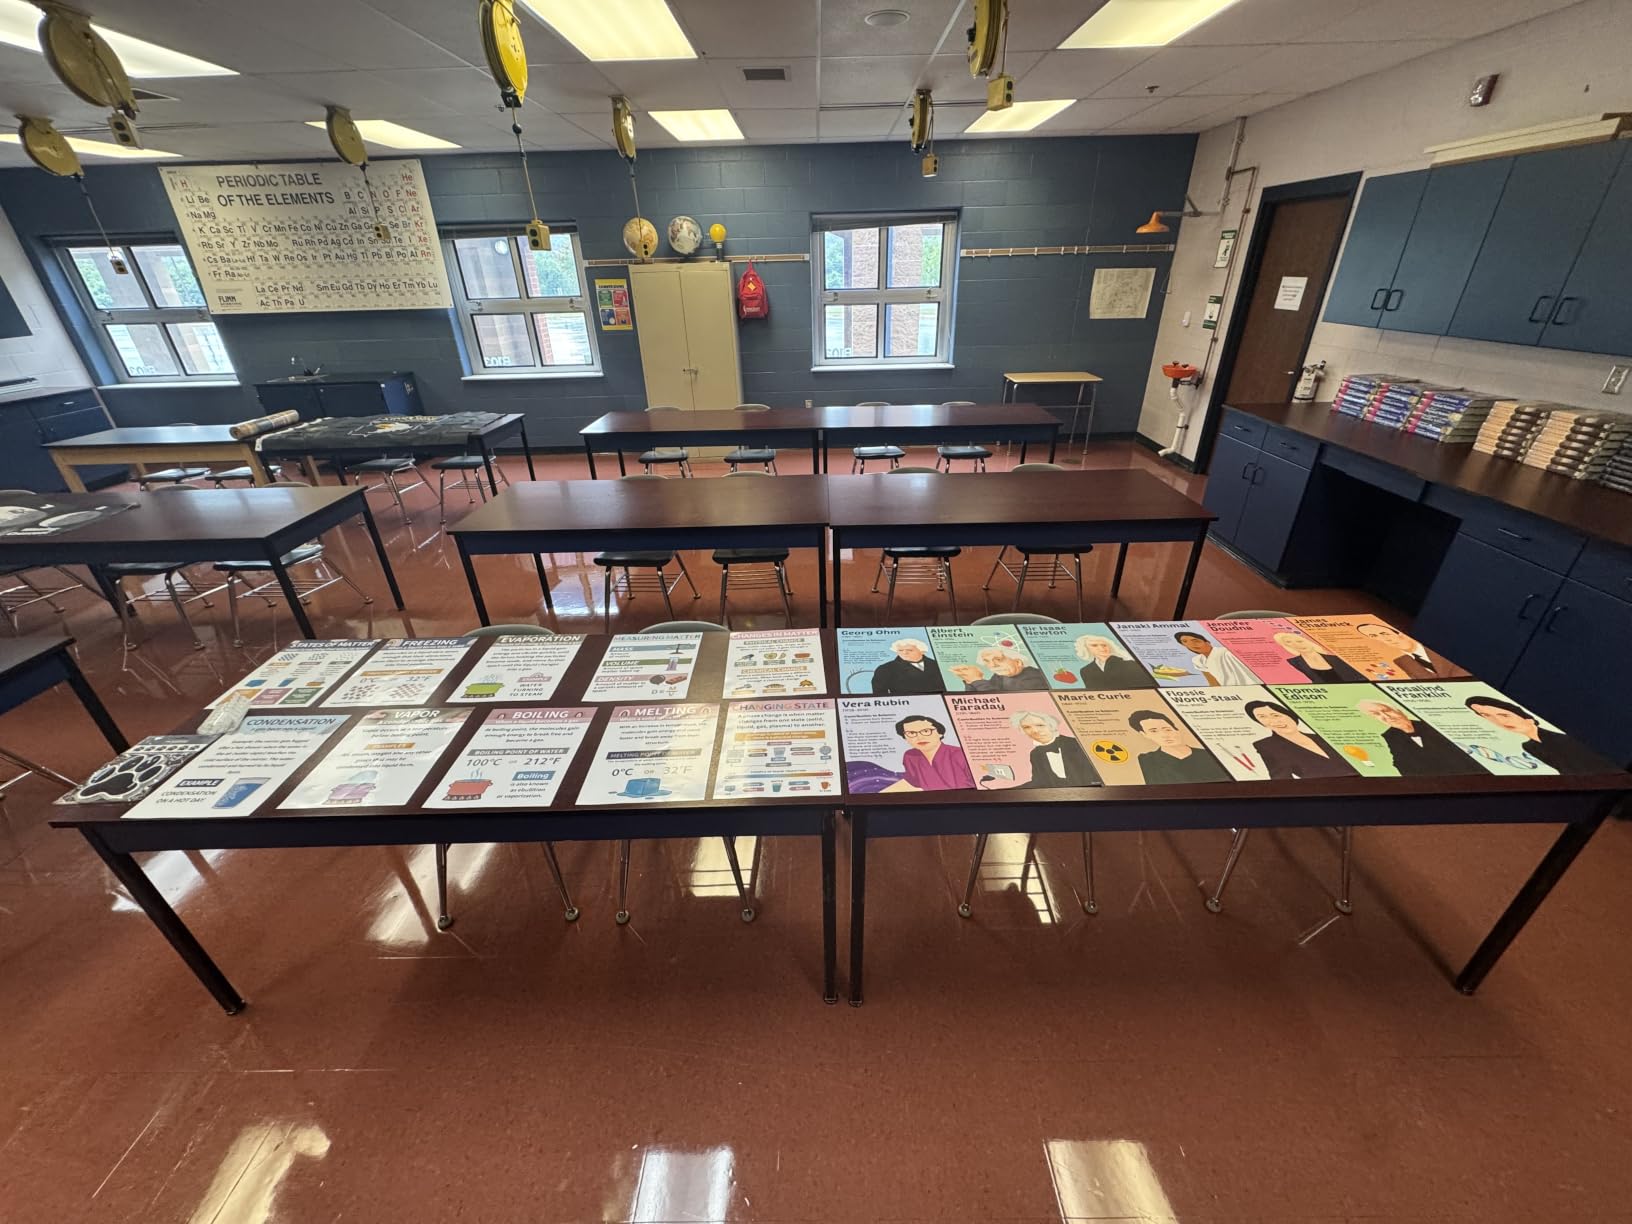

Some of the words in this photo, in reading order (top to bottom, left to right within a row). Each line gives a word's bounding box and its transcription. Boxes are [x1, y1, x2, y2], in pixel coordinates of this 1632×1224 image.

[216, 175, 278, 188] PERIODIC
[280, 173, 322, 186] TABLE
[217, 195, 235, 207] OF
[236, 194, 264, 206] THE
[265, 192, 335, 206] ELEMENTS
[951, 697, 1000, 705] Michael
[1171, 694, 1243, 703] Wong-Staal
[954, 703, 1005, 711] Faraday
[394, 710, 440, 718] VAPOR
[512, 711, 569, 719] BOILING
[634, 707, 696, 716] MELTING
[247, 718, 336, 726] CONDENSATION
[466, 758, 502, 767] 100°C
[523, 757, 561, 765] 212°F
[612, 768, 634, 776] 0°C
